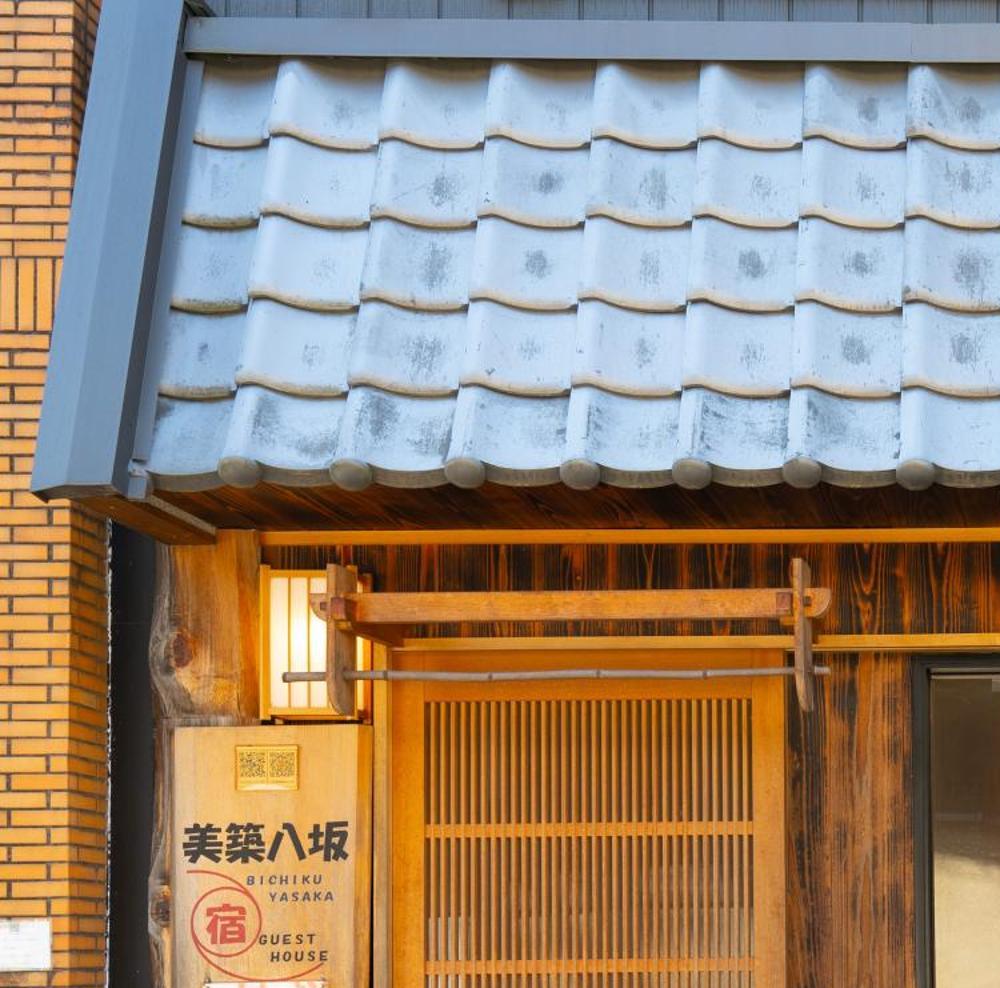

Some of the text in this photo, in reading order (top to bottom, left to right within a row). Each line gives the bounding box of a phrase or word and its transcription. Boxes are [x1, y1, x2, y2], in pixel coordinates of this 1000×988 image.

[182, 821, 349, 864] 美築八坂
[246, 874, 322, 886] BICHIKU
[269, 891, 334, 902] YASAKA
[206, 903, 247, 945] 宿
[258, 933, 316, 945] GUEST
[270, 950, 328, 962] HOUSE
